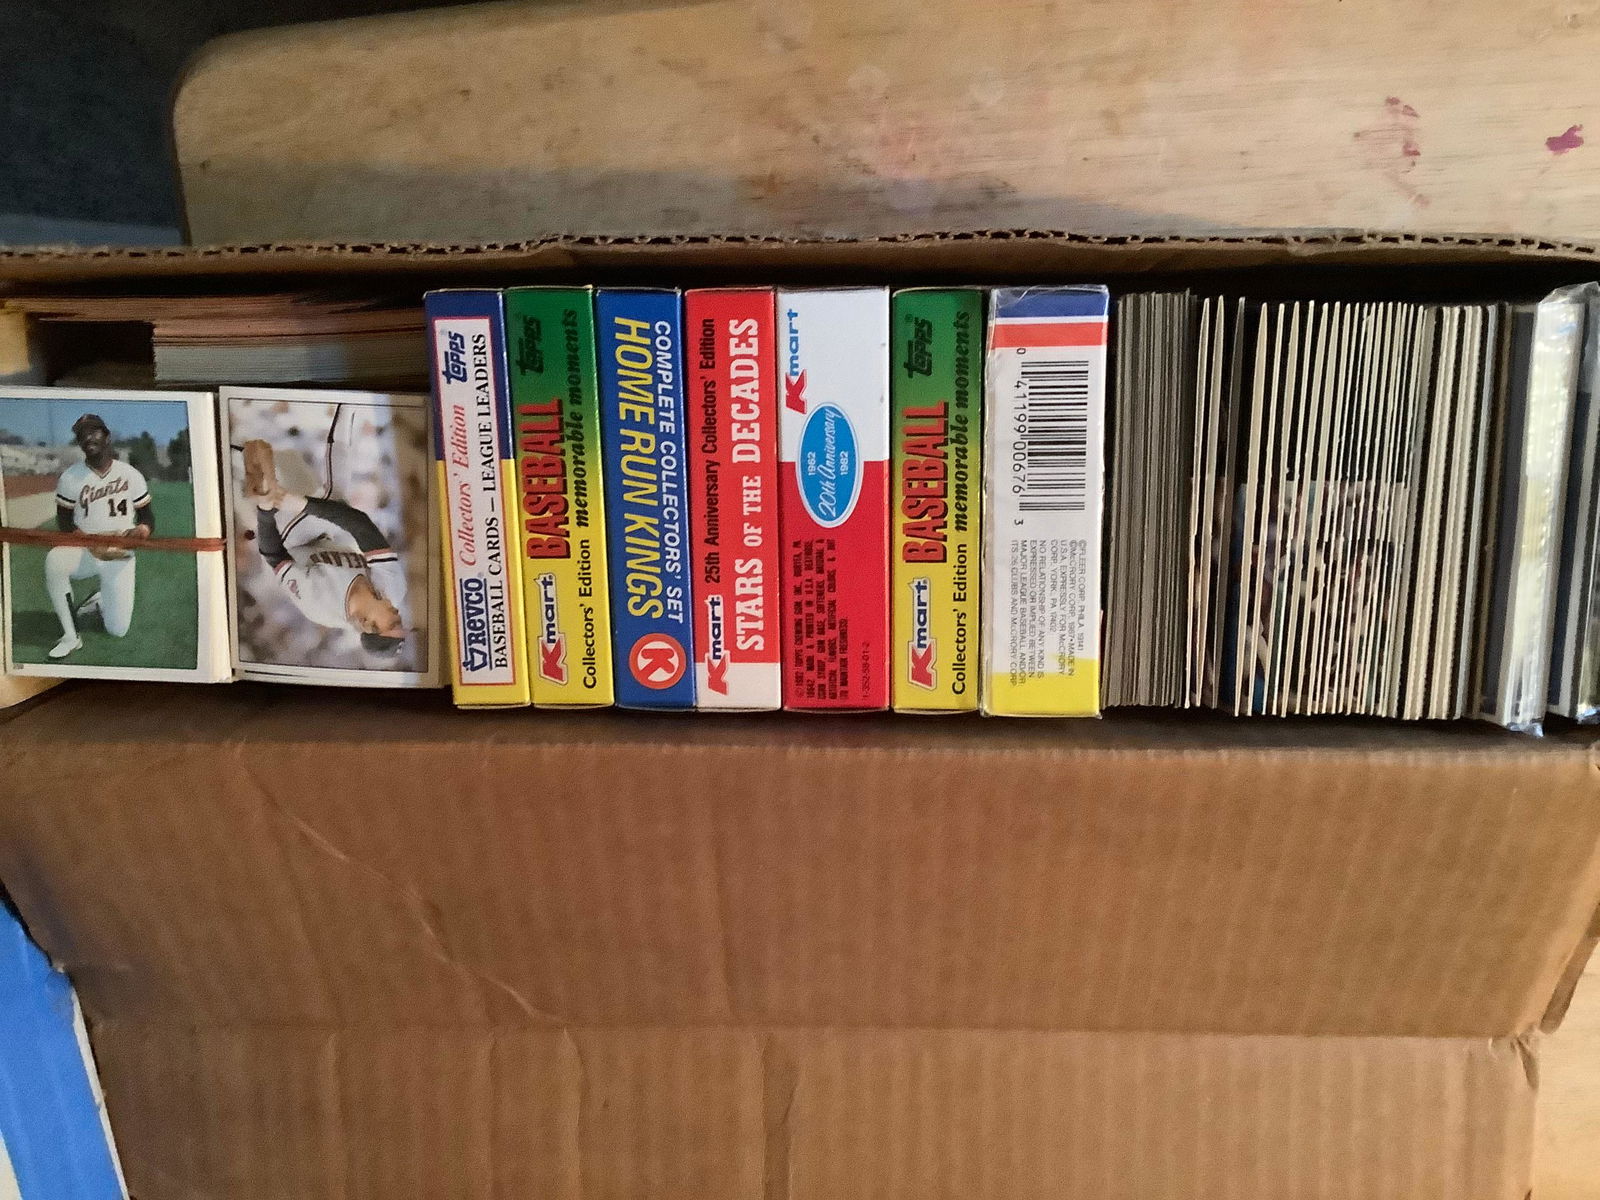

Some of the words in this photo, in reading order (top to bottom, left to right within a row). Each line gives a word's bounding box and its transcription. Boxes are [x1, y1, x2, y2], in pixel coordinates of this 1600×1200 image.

[472, 333, 491, 417] LEADERS
[563, 309, 582, 405] moments
[614, 316, 655, 425] HOME
[655, 320, 675, 435] COMPLETE
[699, 318, 715, 369] Edition
[953, 311, 969, 408] moments
[1016, 347, 1026, 355] 0
[729, 318, 760, 463] DECADES
[1014, 380, 1027, 434] 41199
[450, 404, 469, 469] Edition
[477, 422, 496, 492] LEAGUE
[565, 411, 589, 528] memorable
[619, 428, 658, 506] RUN
[817, 408, 842, 480] Anniversary
[950, 413, 969, 532] memorable
[1012, 441, 1026, 494] 00676
[80, 477, 128, 517] Giants
[108, 499, 127, 516] 14
[517, 397, 571, 559] BASEBALL
[660, 440, 681, 580] COLLECTORS'
[704, 459, 720, 546] Anniversary
[742, 475, 762, 516] THE
[818, 480, 837, 518] 20th
[901, 400, 949, 563] BASEBALL
[454, 473, 476, 566] Collectors'
[485, 516, 502, 576] CARDS
[743, 522, 762, 547] OF
[1020, 540, 1028, 569] MAJOR
[1039, 540, 1046, 553] NO
[578, 539, 592, 597] Edition
[623, 513, 664, 619] KINGS
[705, 551, 721, 584] 25th
[953, 543, 967, 602] Edition
[1030, 591, 1037, 603] OR
[490, 580, 508, 668] BASEBALL
[666, 585, 683, 624] SET
[735, 558, 764, 651] STARS
[579, 603, 597, 689] Collectors'
[952, 609, 967, 695] Collectors'
